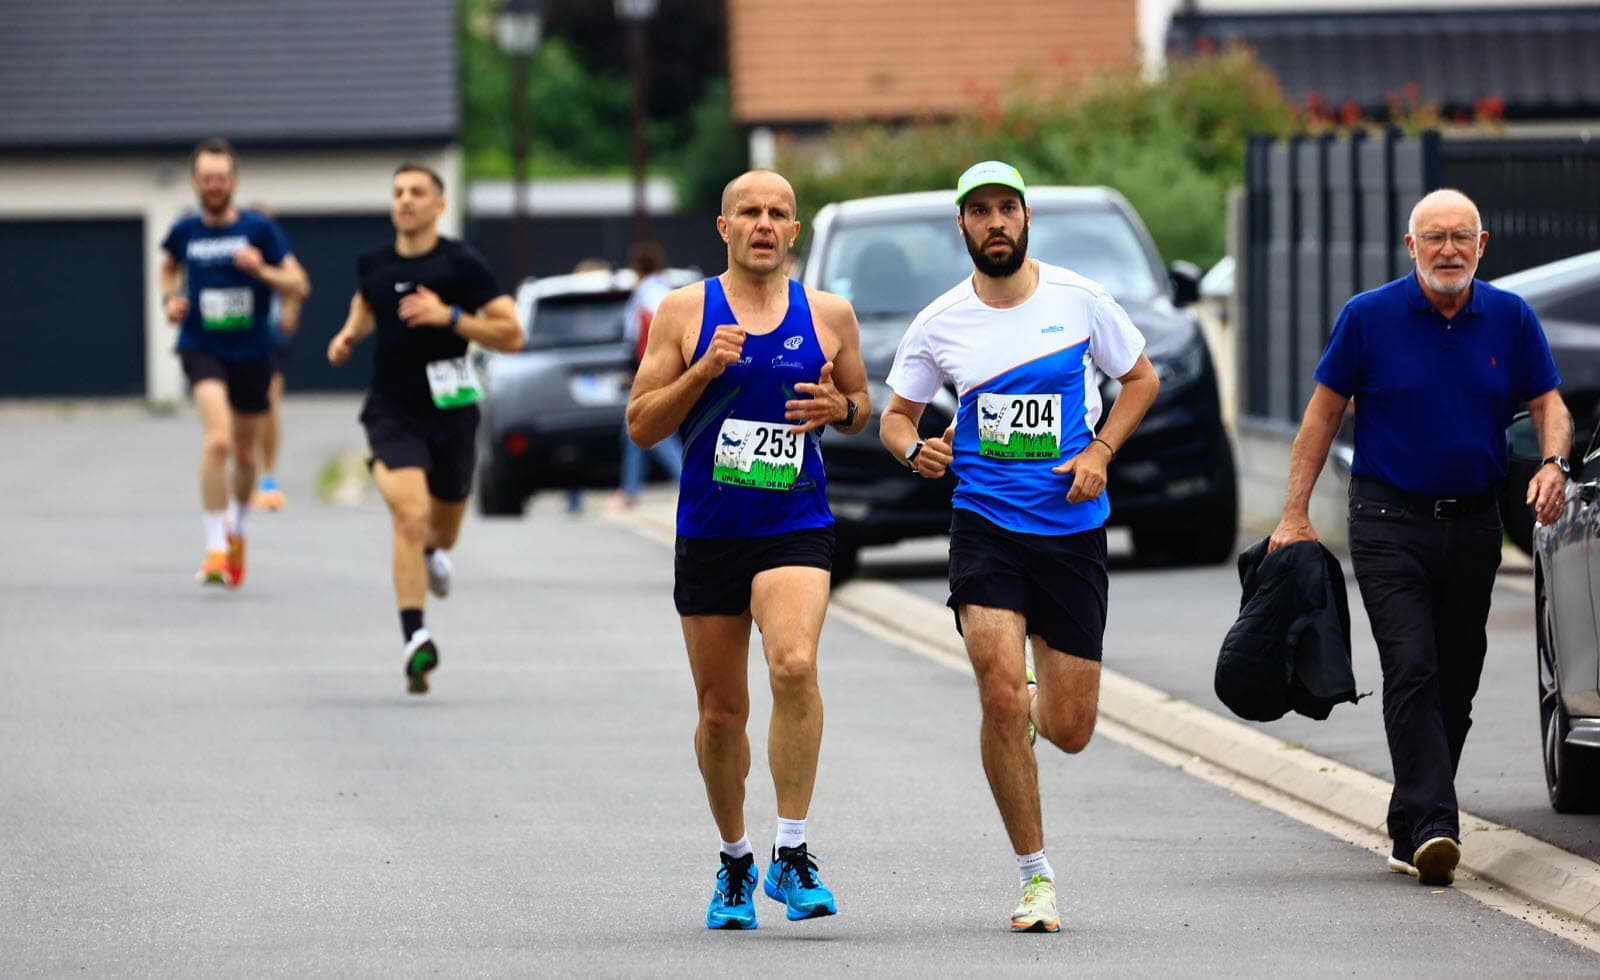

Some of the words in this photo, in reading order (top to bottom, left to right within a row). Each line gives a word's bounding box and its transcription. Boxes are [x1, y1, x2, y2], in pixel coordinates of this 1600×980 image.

[1010, 399, 1054, 428] 204
[754, 427, 797, 459] 253
[766, 480, 777, 488] DE
